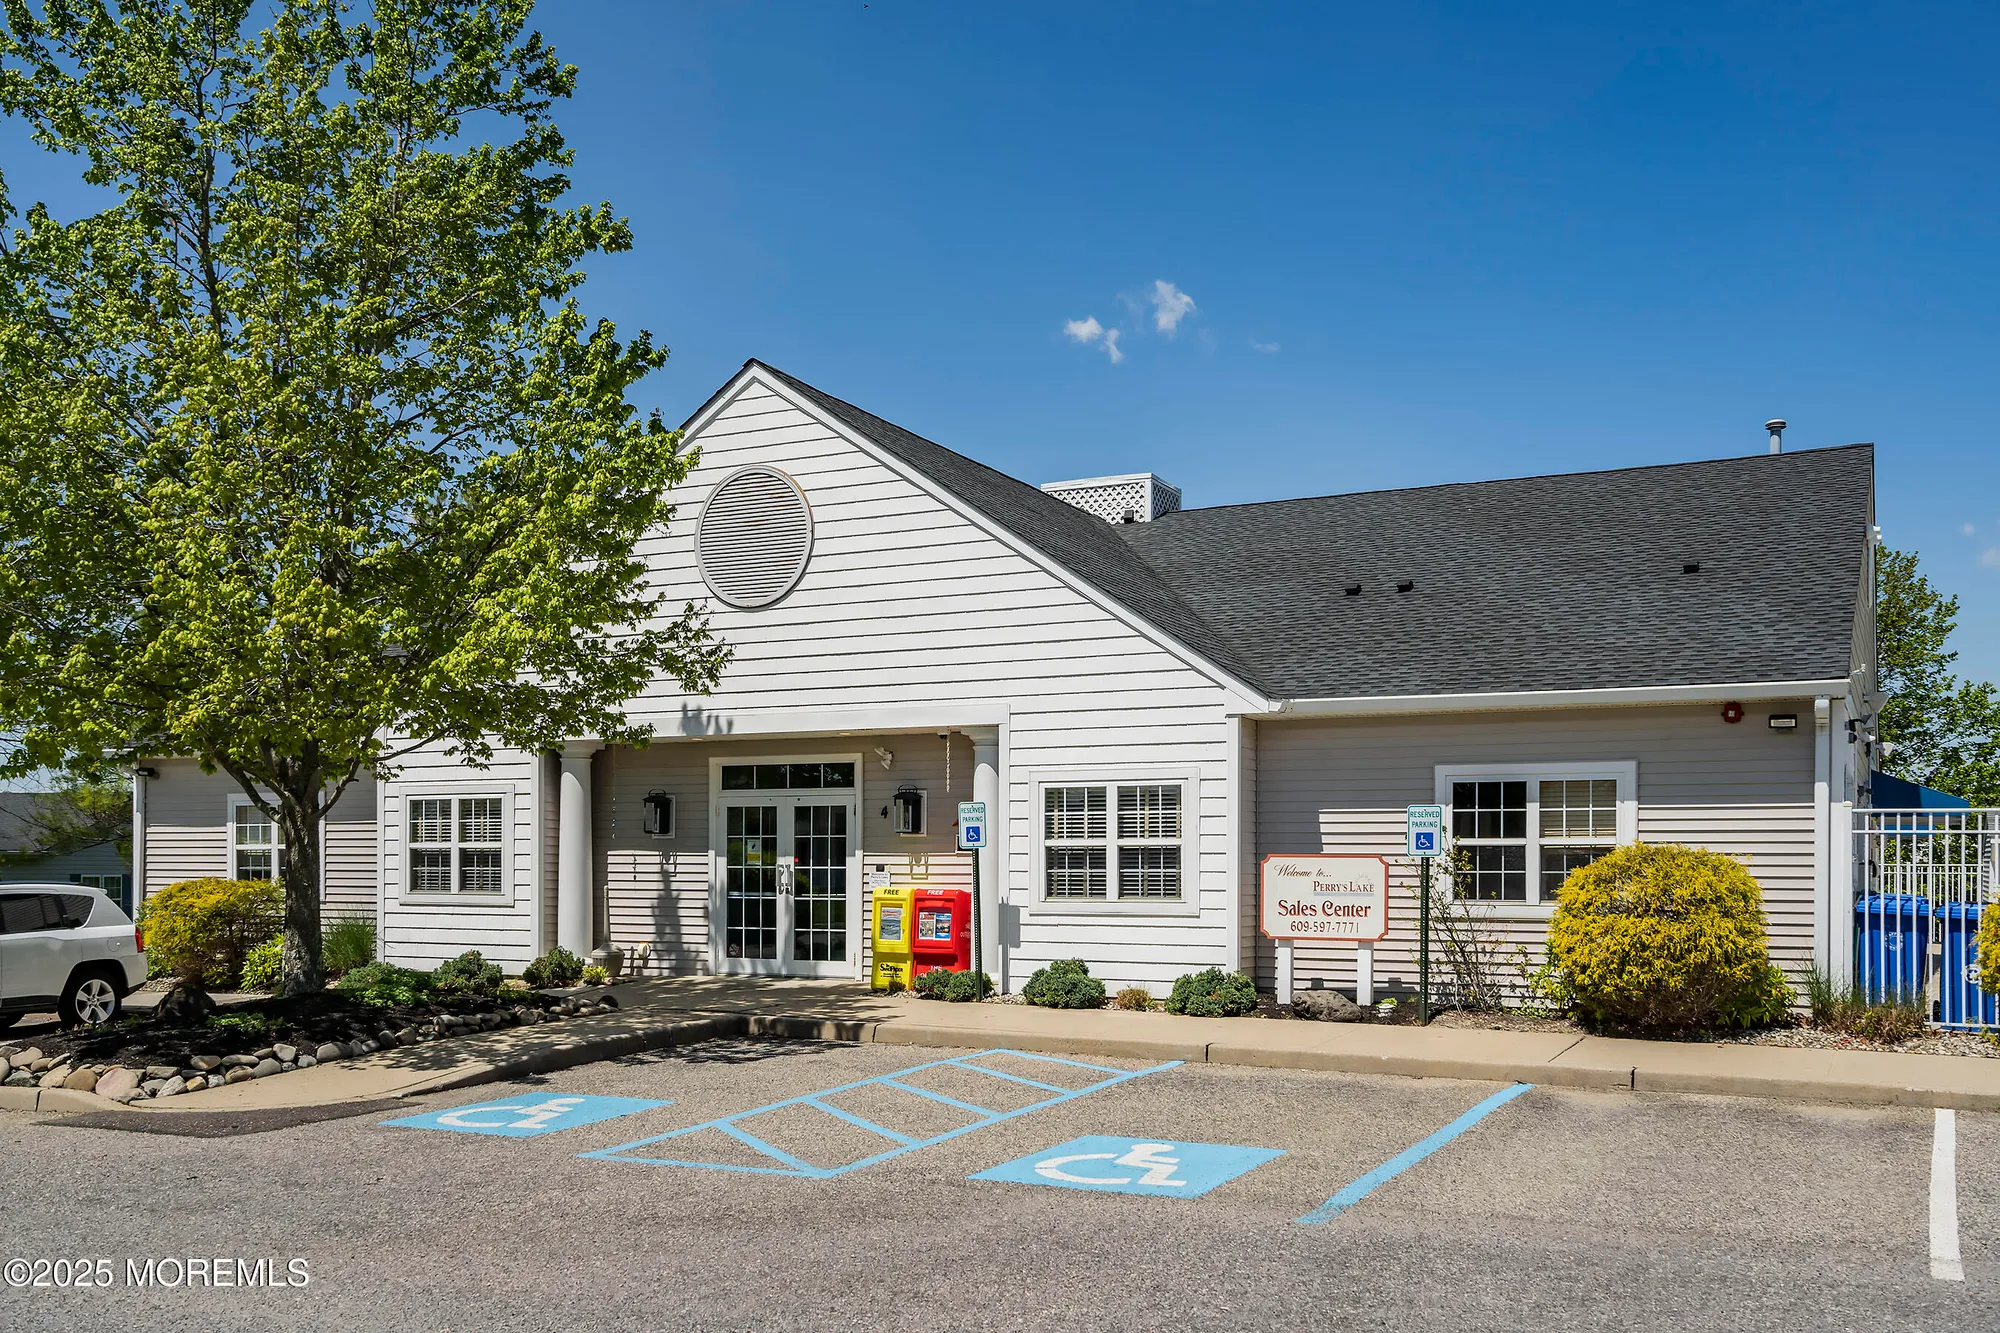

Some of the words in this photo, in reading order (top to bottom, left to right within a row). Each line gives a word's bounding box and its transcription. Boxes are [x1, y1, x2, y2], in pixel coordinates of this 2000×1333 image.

[881, 805, 888, 819] 4
[1274, 863, 1312, 877] Welcome
[1313, 881, 1348, 892] PERRY'S
[1349, 881, 1375, 892] LAKE
[1278, 900, 1318, 917] Sales
[1321, 900, 1371, 918] Center
[1290, 921, 1359, 933] 609-597-7771
